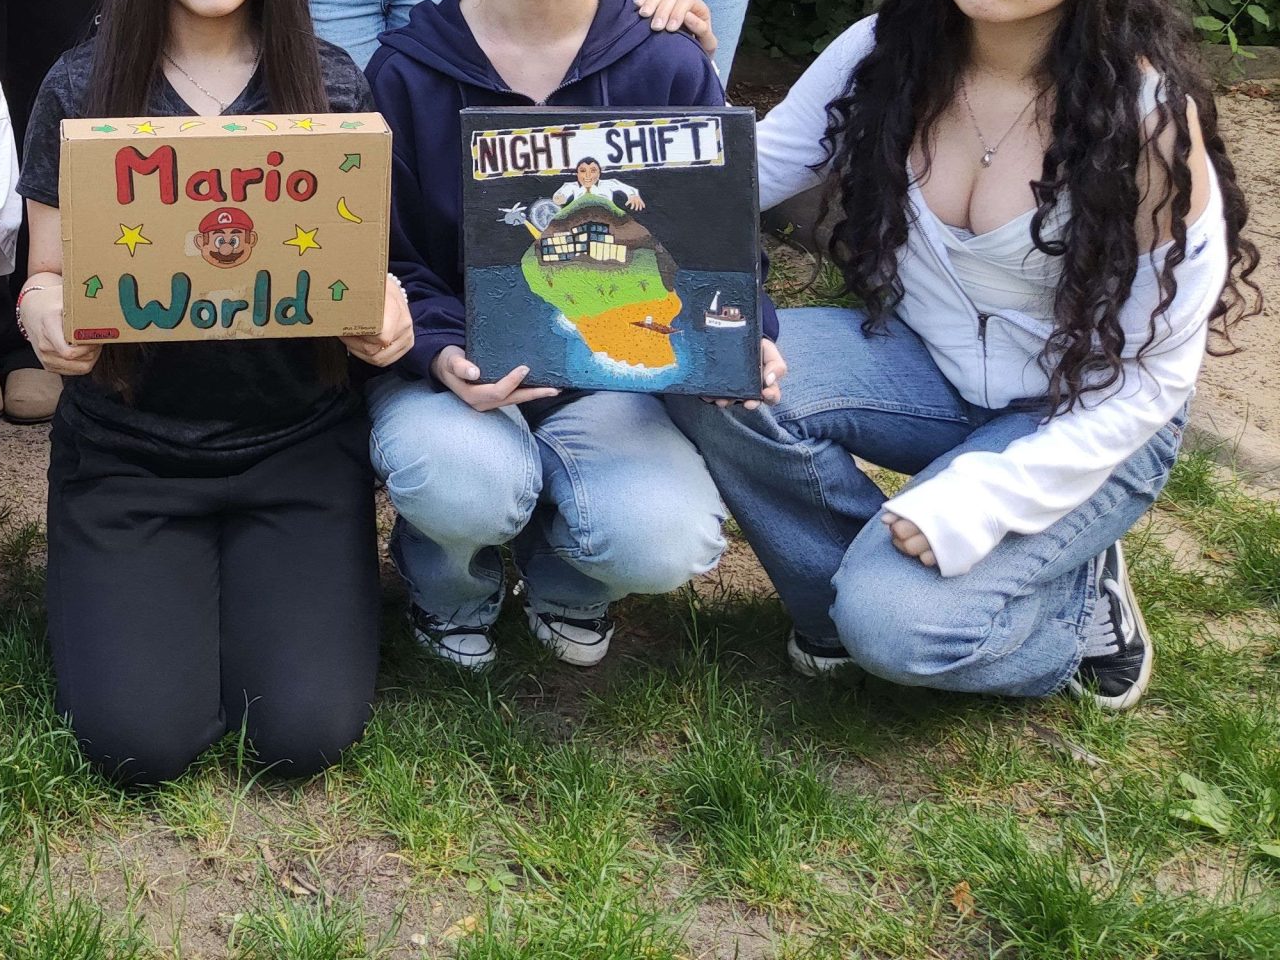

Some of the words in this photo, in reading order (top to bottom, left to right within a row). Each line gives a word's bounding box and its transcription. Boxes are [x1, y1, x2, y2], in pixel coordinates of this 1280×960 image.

[114, 144, 318, 205] Mario
[479, 131, 576, 172] NIGHT
[606, 122, 709, 163] SHIFT
[118, 270, 314, 330] World
